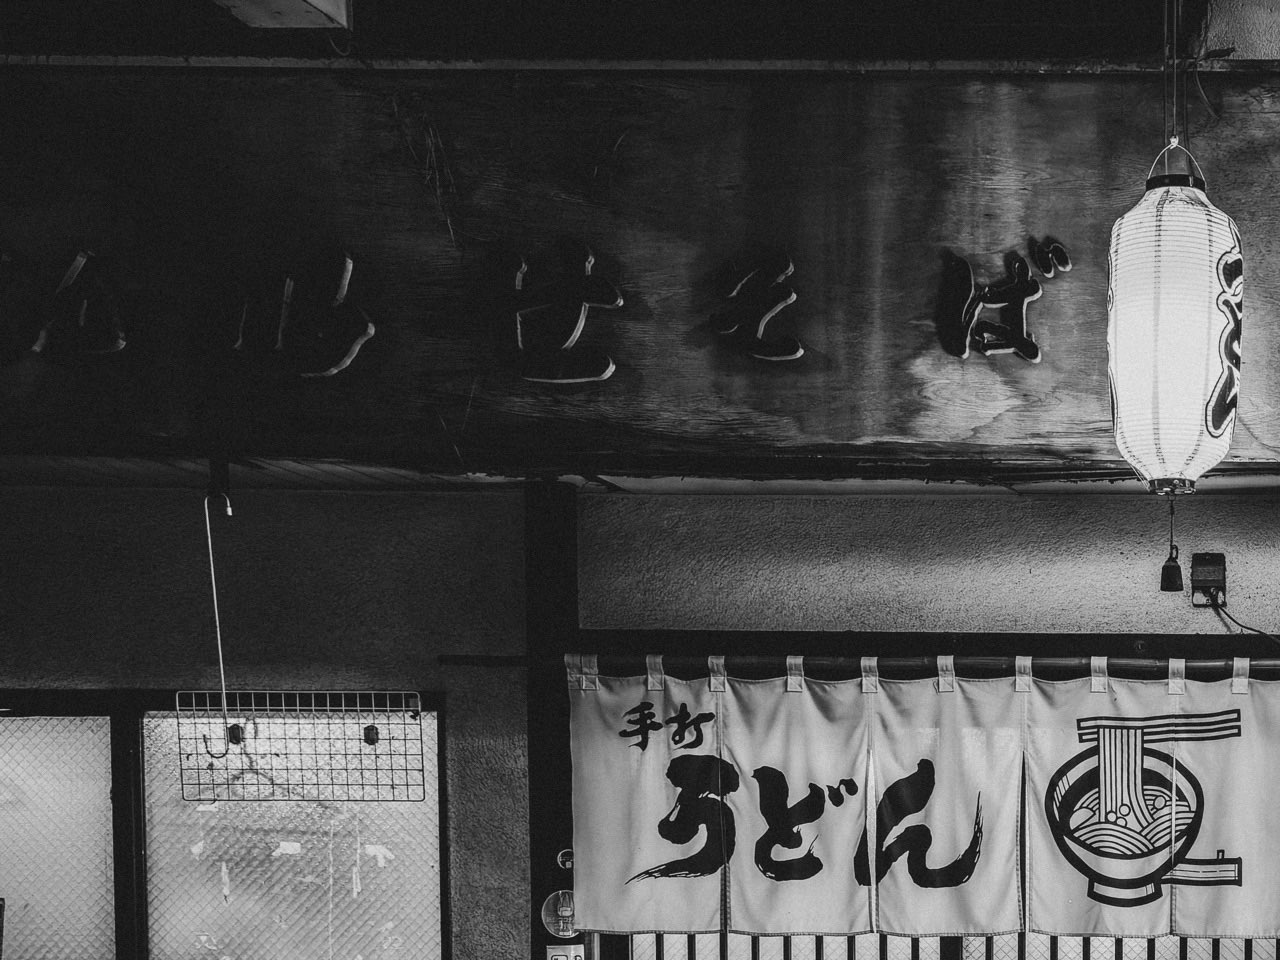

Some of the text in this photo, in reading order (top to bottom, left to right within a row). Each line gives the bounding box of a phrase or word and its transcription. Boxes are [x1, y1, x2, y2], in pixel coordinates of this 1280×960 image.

[618, 701, 716, 752] 手打
[624, 753, 984, 889] うどん
